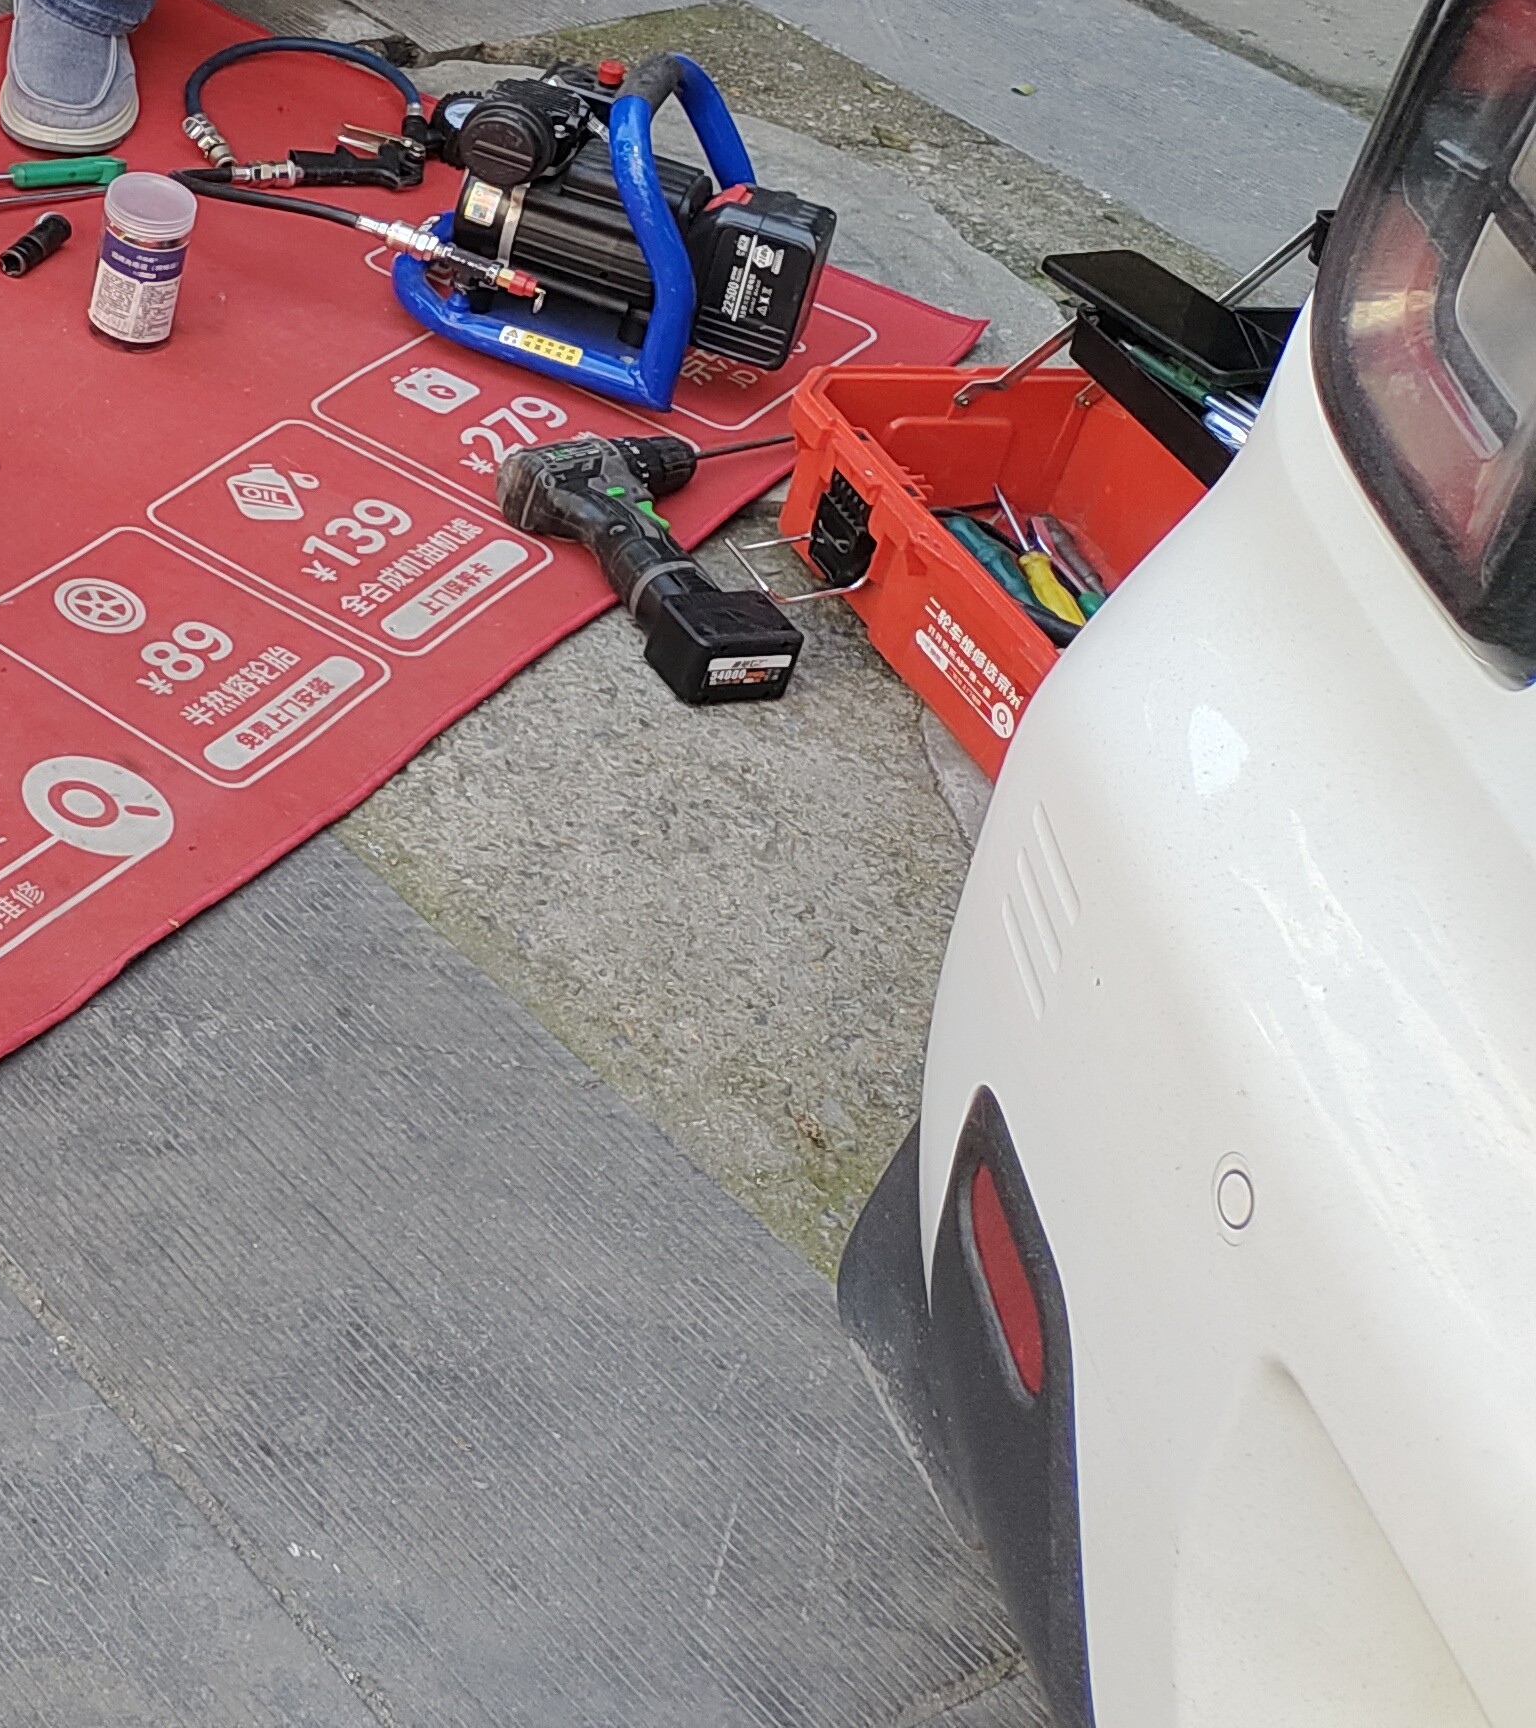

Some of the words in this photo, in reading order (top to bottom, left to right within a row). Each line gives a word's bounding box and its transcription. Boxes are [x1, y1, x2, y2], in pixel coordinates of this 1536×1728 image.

[242, 487, 285, 504] OIL
[301, 499, 413, 583] ¥139
[136, 621, 233, 695] ¥89
[180, 646, 302, 726] 半热熔轮胎
